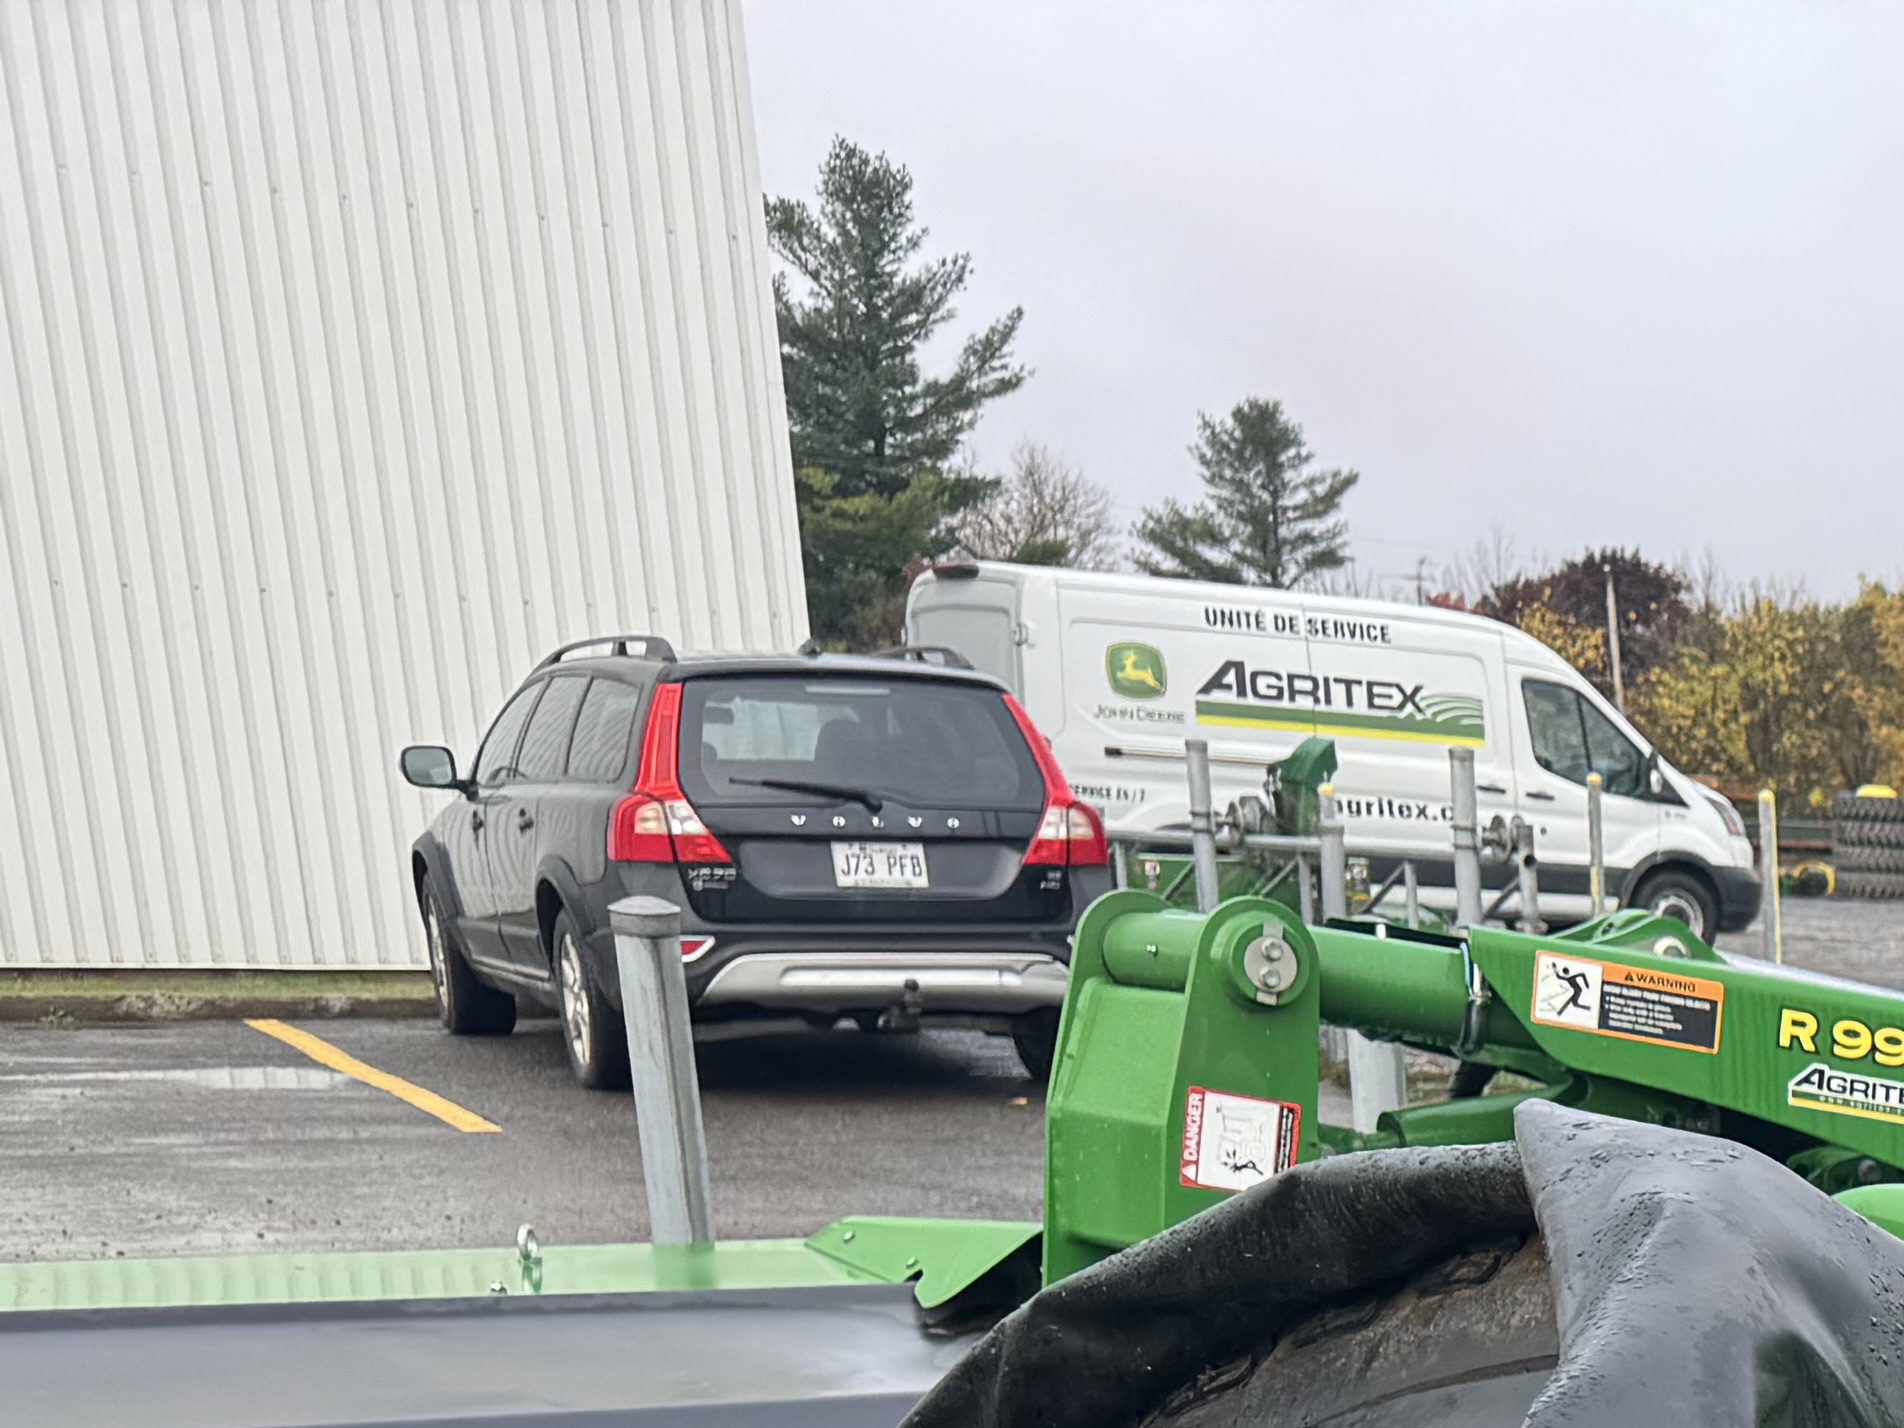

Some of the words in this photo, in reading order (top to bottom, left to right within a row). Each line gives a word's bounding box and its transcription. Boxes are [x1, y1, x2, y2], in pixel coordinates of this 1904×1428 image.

[1204, 606, 1267, 632] UNITÉ
[1274, 614, 1300, 635] DE
[1306, 617, 1392, 643] SERVICE
[1199, 660, 1428, 716] AGRITEX
[790, 814, 961, 830] VOLVO
[840, 853, 875, 878] J73
[1636, 972, 1696, 993] WARNING
[1778, 1008, 1819, 1054] R
[1183, 1093, 1203, 1161] DANGER
